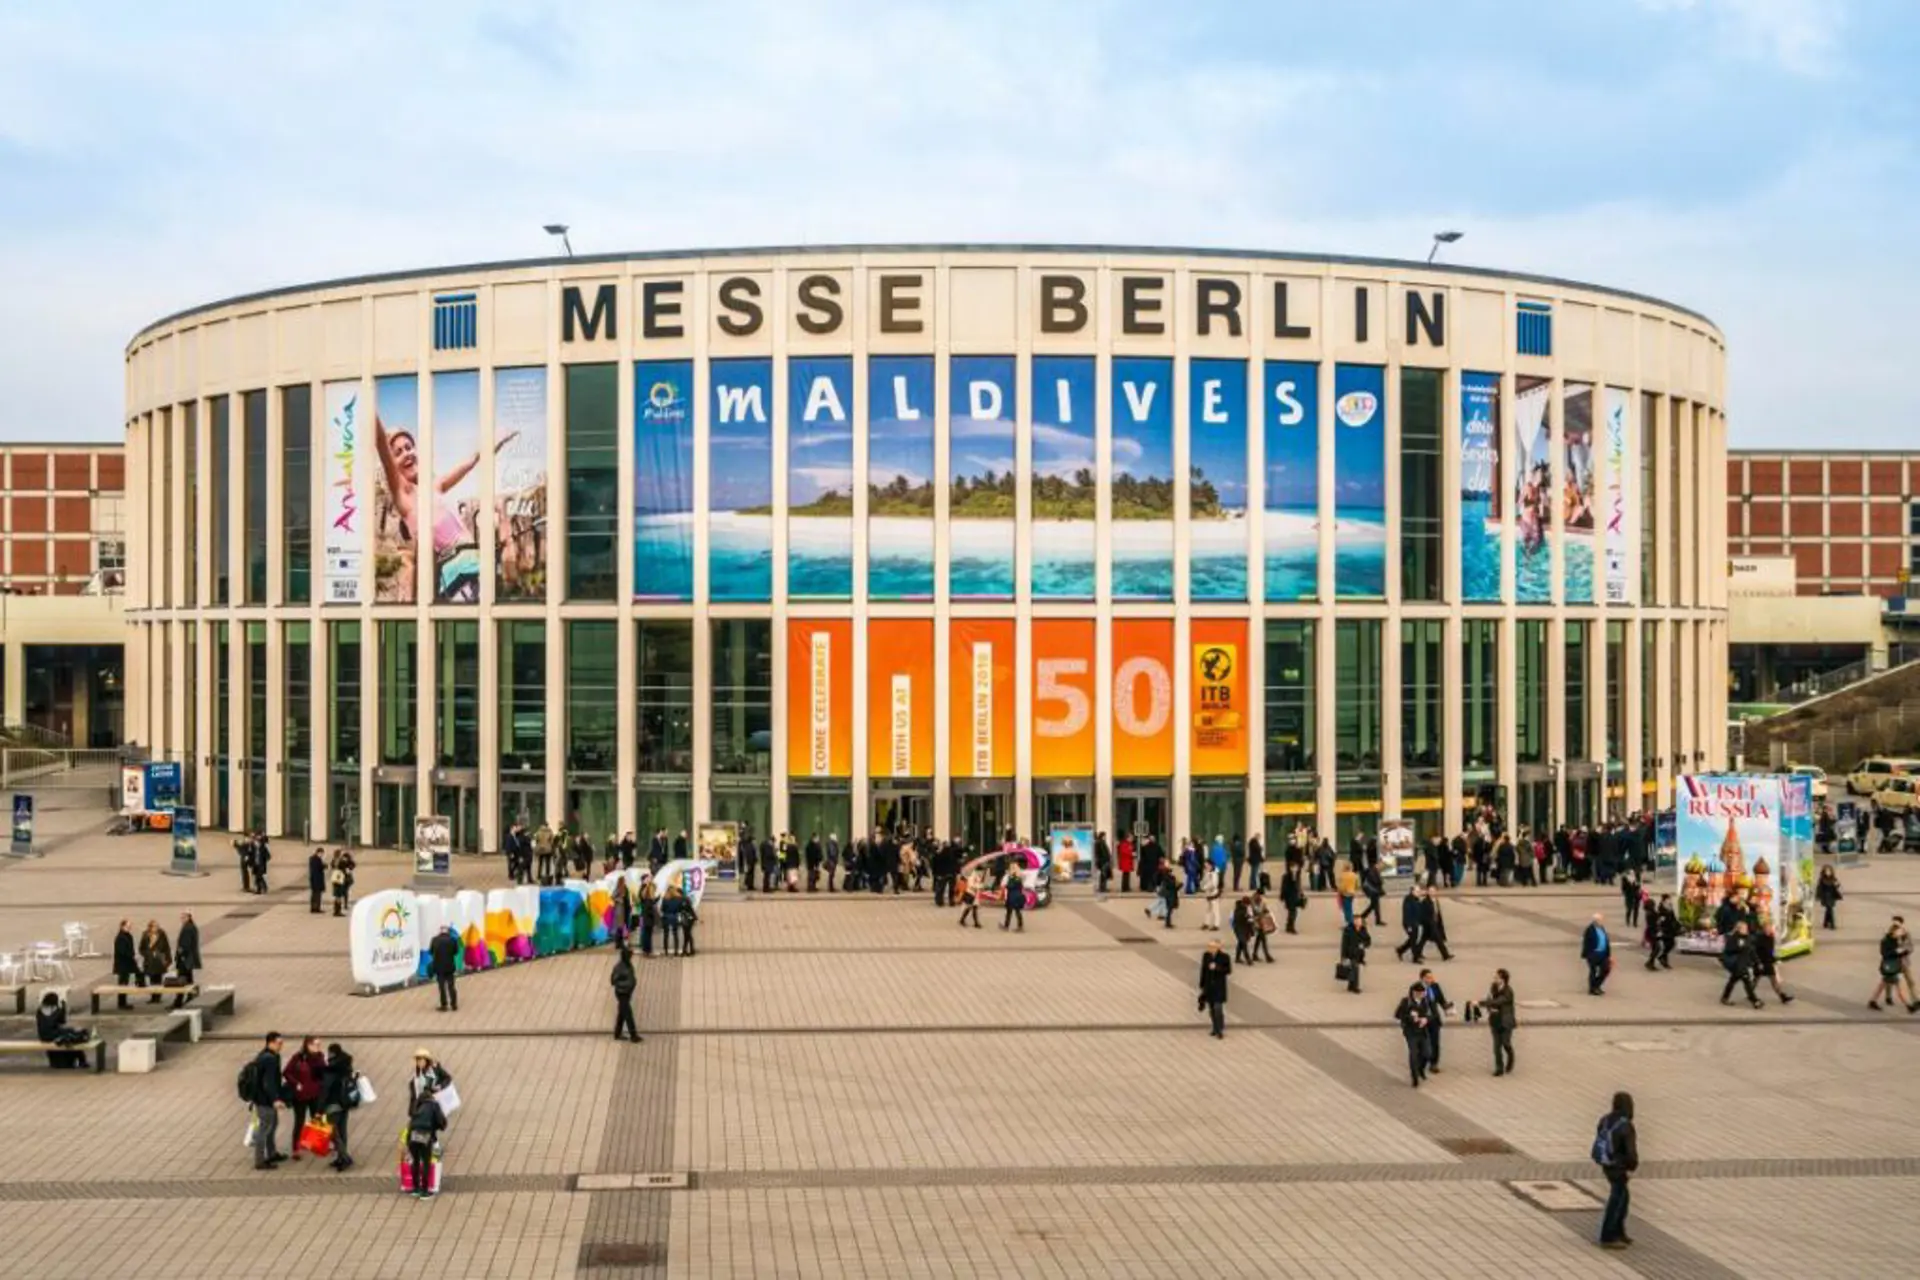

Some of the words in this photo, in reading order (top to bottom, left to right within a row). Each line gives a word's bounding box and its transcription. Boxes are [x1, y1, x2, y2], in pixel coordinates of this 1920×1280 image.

[563, 275, 924, 342] MESSE
[1040, 275, 1445, 347] BERLIN
[815, 641, 826, 723] CELEBRATE
[896, 688, 907, 706] AT
[1034, 655, 1172, 738] 50
[1200, 685, 1231, 702] ITB
[896, 710, 907, 730] US
[977, 692, 988, 746] BERLIN
[815, 727, 826, 771] COME
[896, 734, 907, 771] WITH
[977, 750, 988, 772] ITB
[1688, 798, 1770, 819] RUSSIA
